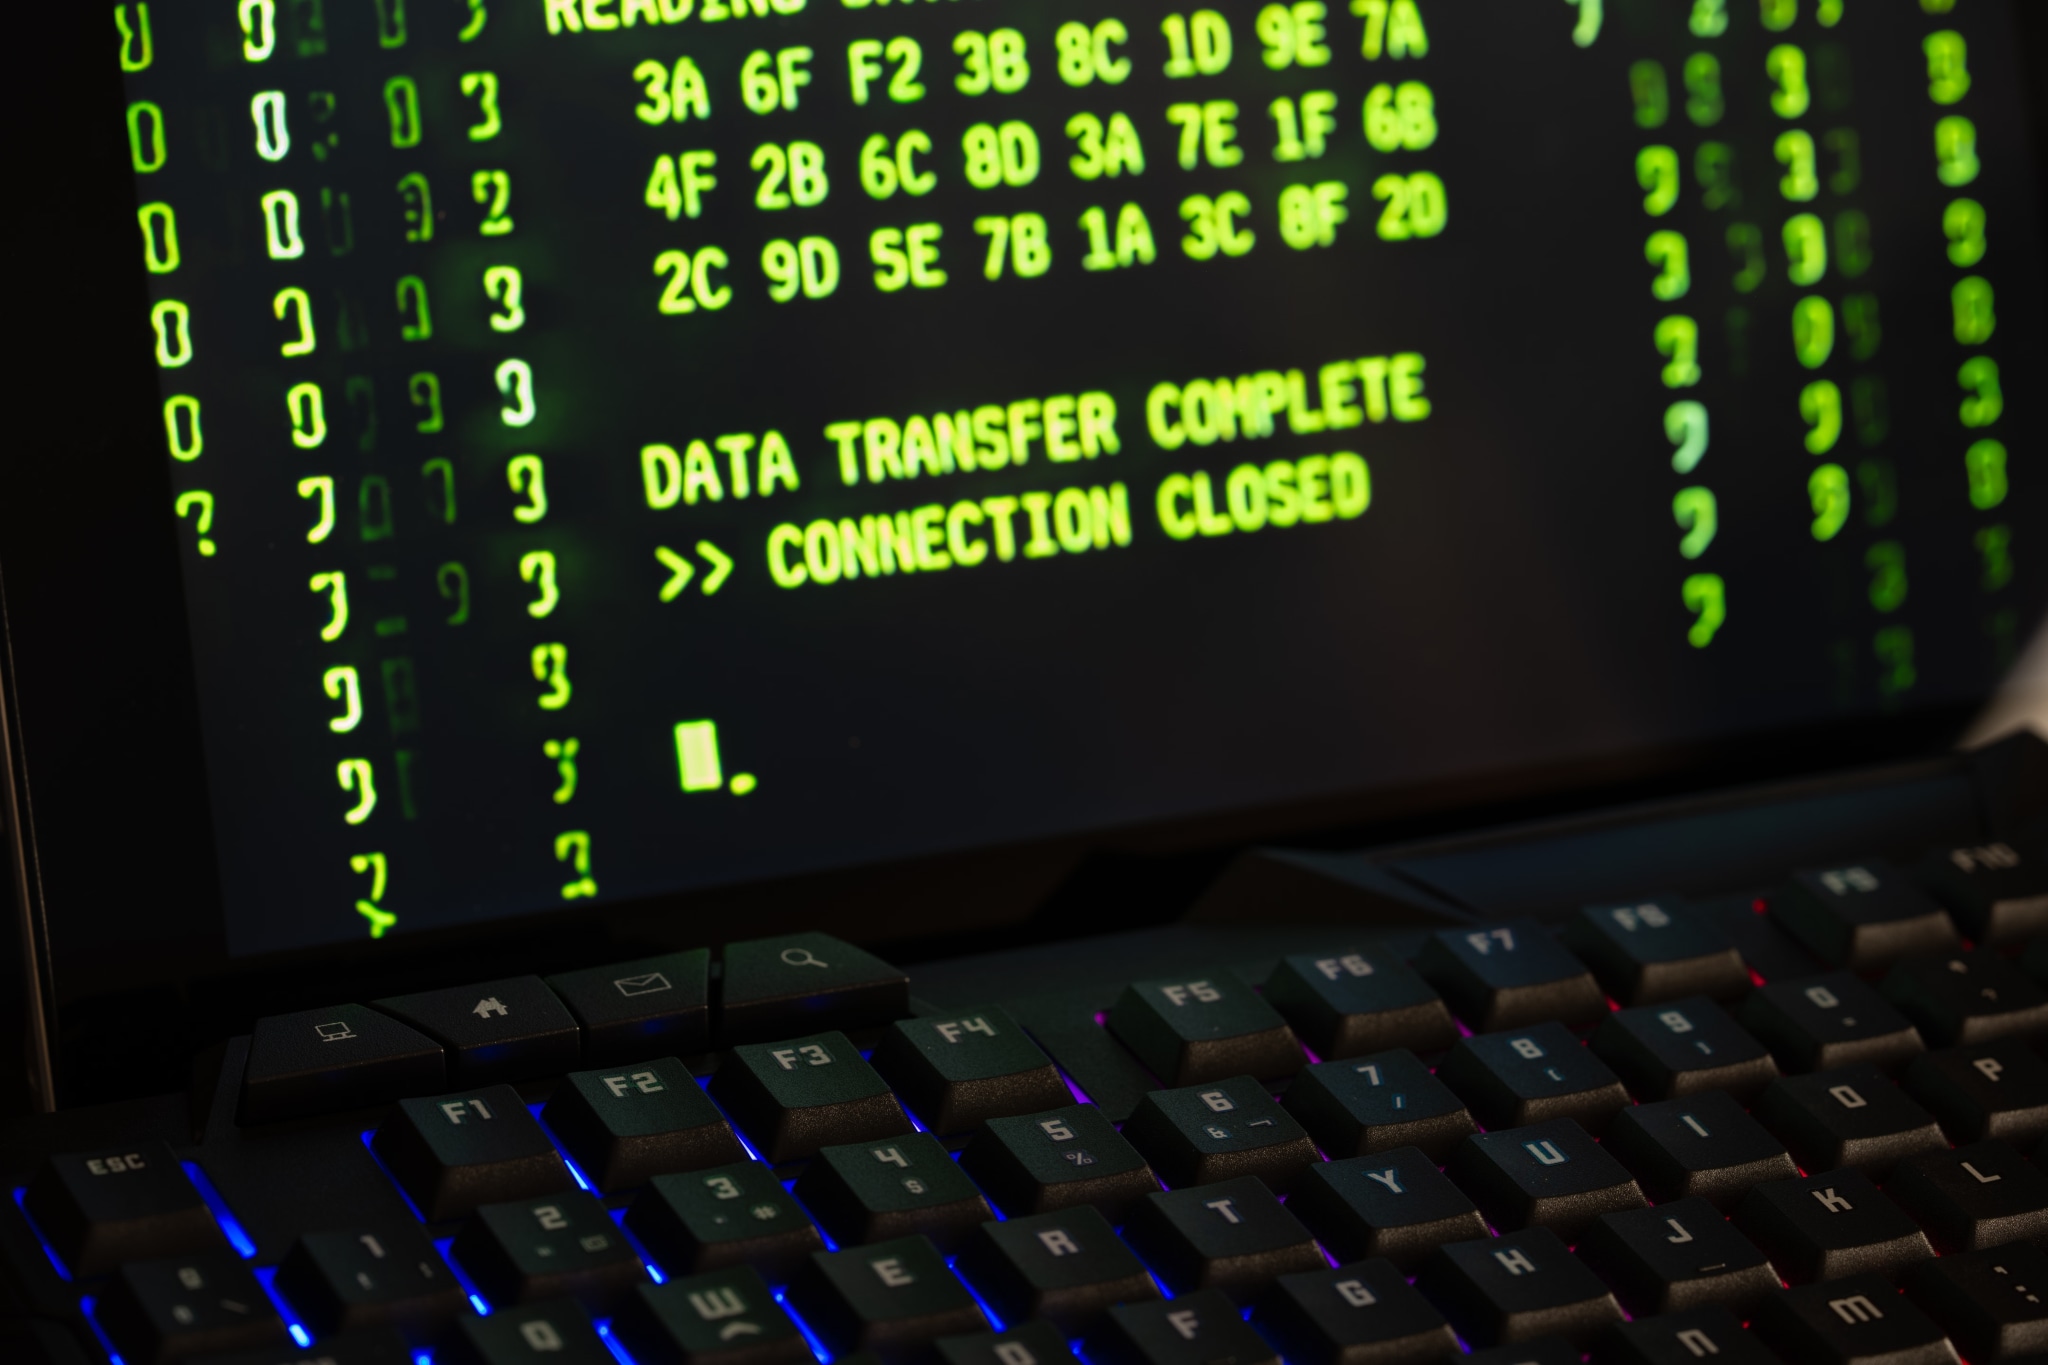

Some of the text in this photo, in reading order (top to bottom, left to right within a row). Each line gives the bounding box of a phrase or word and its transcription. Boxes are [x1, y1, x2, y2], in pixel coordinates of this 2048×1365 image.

[633, 0, 1428, 125] 3A 6F F2 3B 8C 1D 9E 7A
[645, 150, 716, 220] 4F
[750, 141, 829, 210] 2B
[859, 130, 937, 199] 6C
[962, 120, 1040, 189] 8D
[1065, 112, 1145, 180] 3A
[1166, 100, 1243, 169] 7E
[1269, 90, 1337, 162] 1F
[654, 246, 732, 315] 2C
[761, 236, 840, 302] 9D
[974, 212, 1052, 280] 7B
[1079, 202, 1156, 270] 1A
[1179, 191, 1255, 260] 3C
[641, 353, 1430, 509] DATA TRANSFER COMPLETE
[767, 482, 1132, 588] CONNECTION
[1156, 452, 1371, 539] CLOSED
[1466, 928, 1515, 955] F7
[1161, 980, 1221, 1007] F5
[935, 1017, 996, 1044] F4
[771, 1044, 831, 1070] F3
[603, 1071, 664, 1098] F2
[1356, 1065, 1380, 1086] 7
[440, 1099, 492, 1125] F1
[1200, 1091, 1234, 1112] 6
[1039, 1119, 1074, 1141] 5
[86, 1153, 145, 1176] ESC
[873, 1147, 908, 1168] 4
[1525, 1140, 1566, 1165] U
[1367, 1169, 1403, 1194] Y
[1960, 1161, 2002, 1184] L
[706, 1176, 740, 1200] 3
[1811, 1187, 1853, 1213] K
[533, 1205, 567, 1230] 2
[1206, 1199, 1240, 1224] T
[1037, 1229, 1079, 1256] R
[1666, 1218, 1694, 1244] J
[871, 1258, 913, 1287] E
[1494, 1249, 1536, 1275] H
[1335, 1279, 1376, 1307] G
[1167, 1310, 1198, 1339] F
